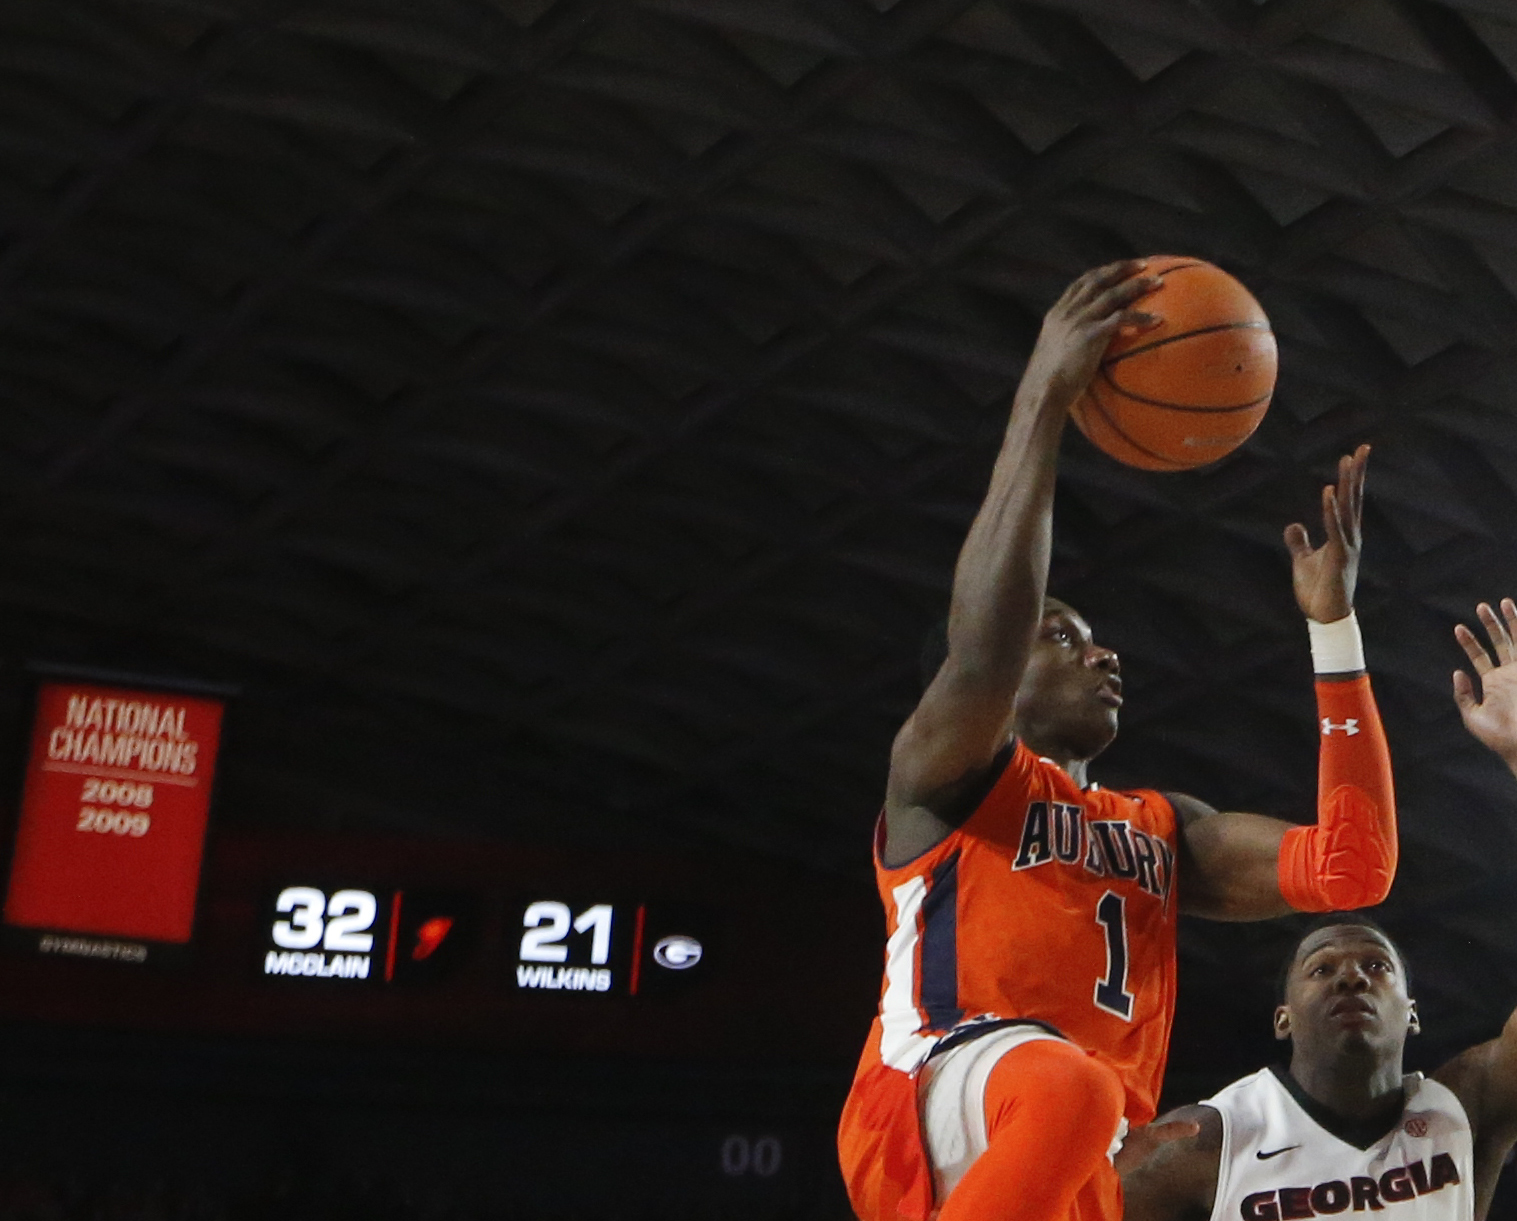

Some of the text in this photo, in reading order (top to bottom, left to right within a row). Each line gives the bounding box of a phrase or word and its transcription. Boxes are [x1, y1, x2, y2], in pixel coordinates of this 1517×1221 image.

[66, 694, 189, 741] NATIONAL
[48, 726, 199, 776] CHAMPIONS
[80, 778, 154, 810] 2008
[76, 806, 150, 838] 2009
[272, 886, 377, 952] 32
[519, 901, 614, 965] 21
[264, 950, 371, 979] MCCLAIN
[516, 964, 612, 992] WILKINS
[1093, 888, 1136, 1023] 1
